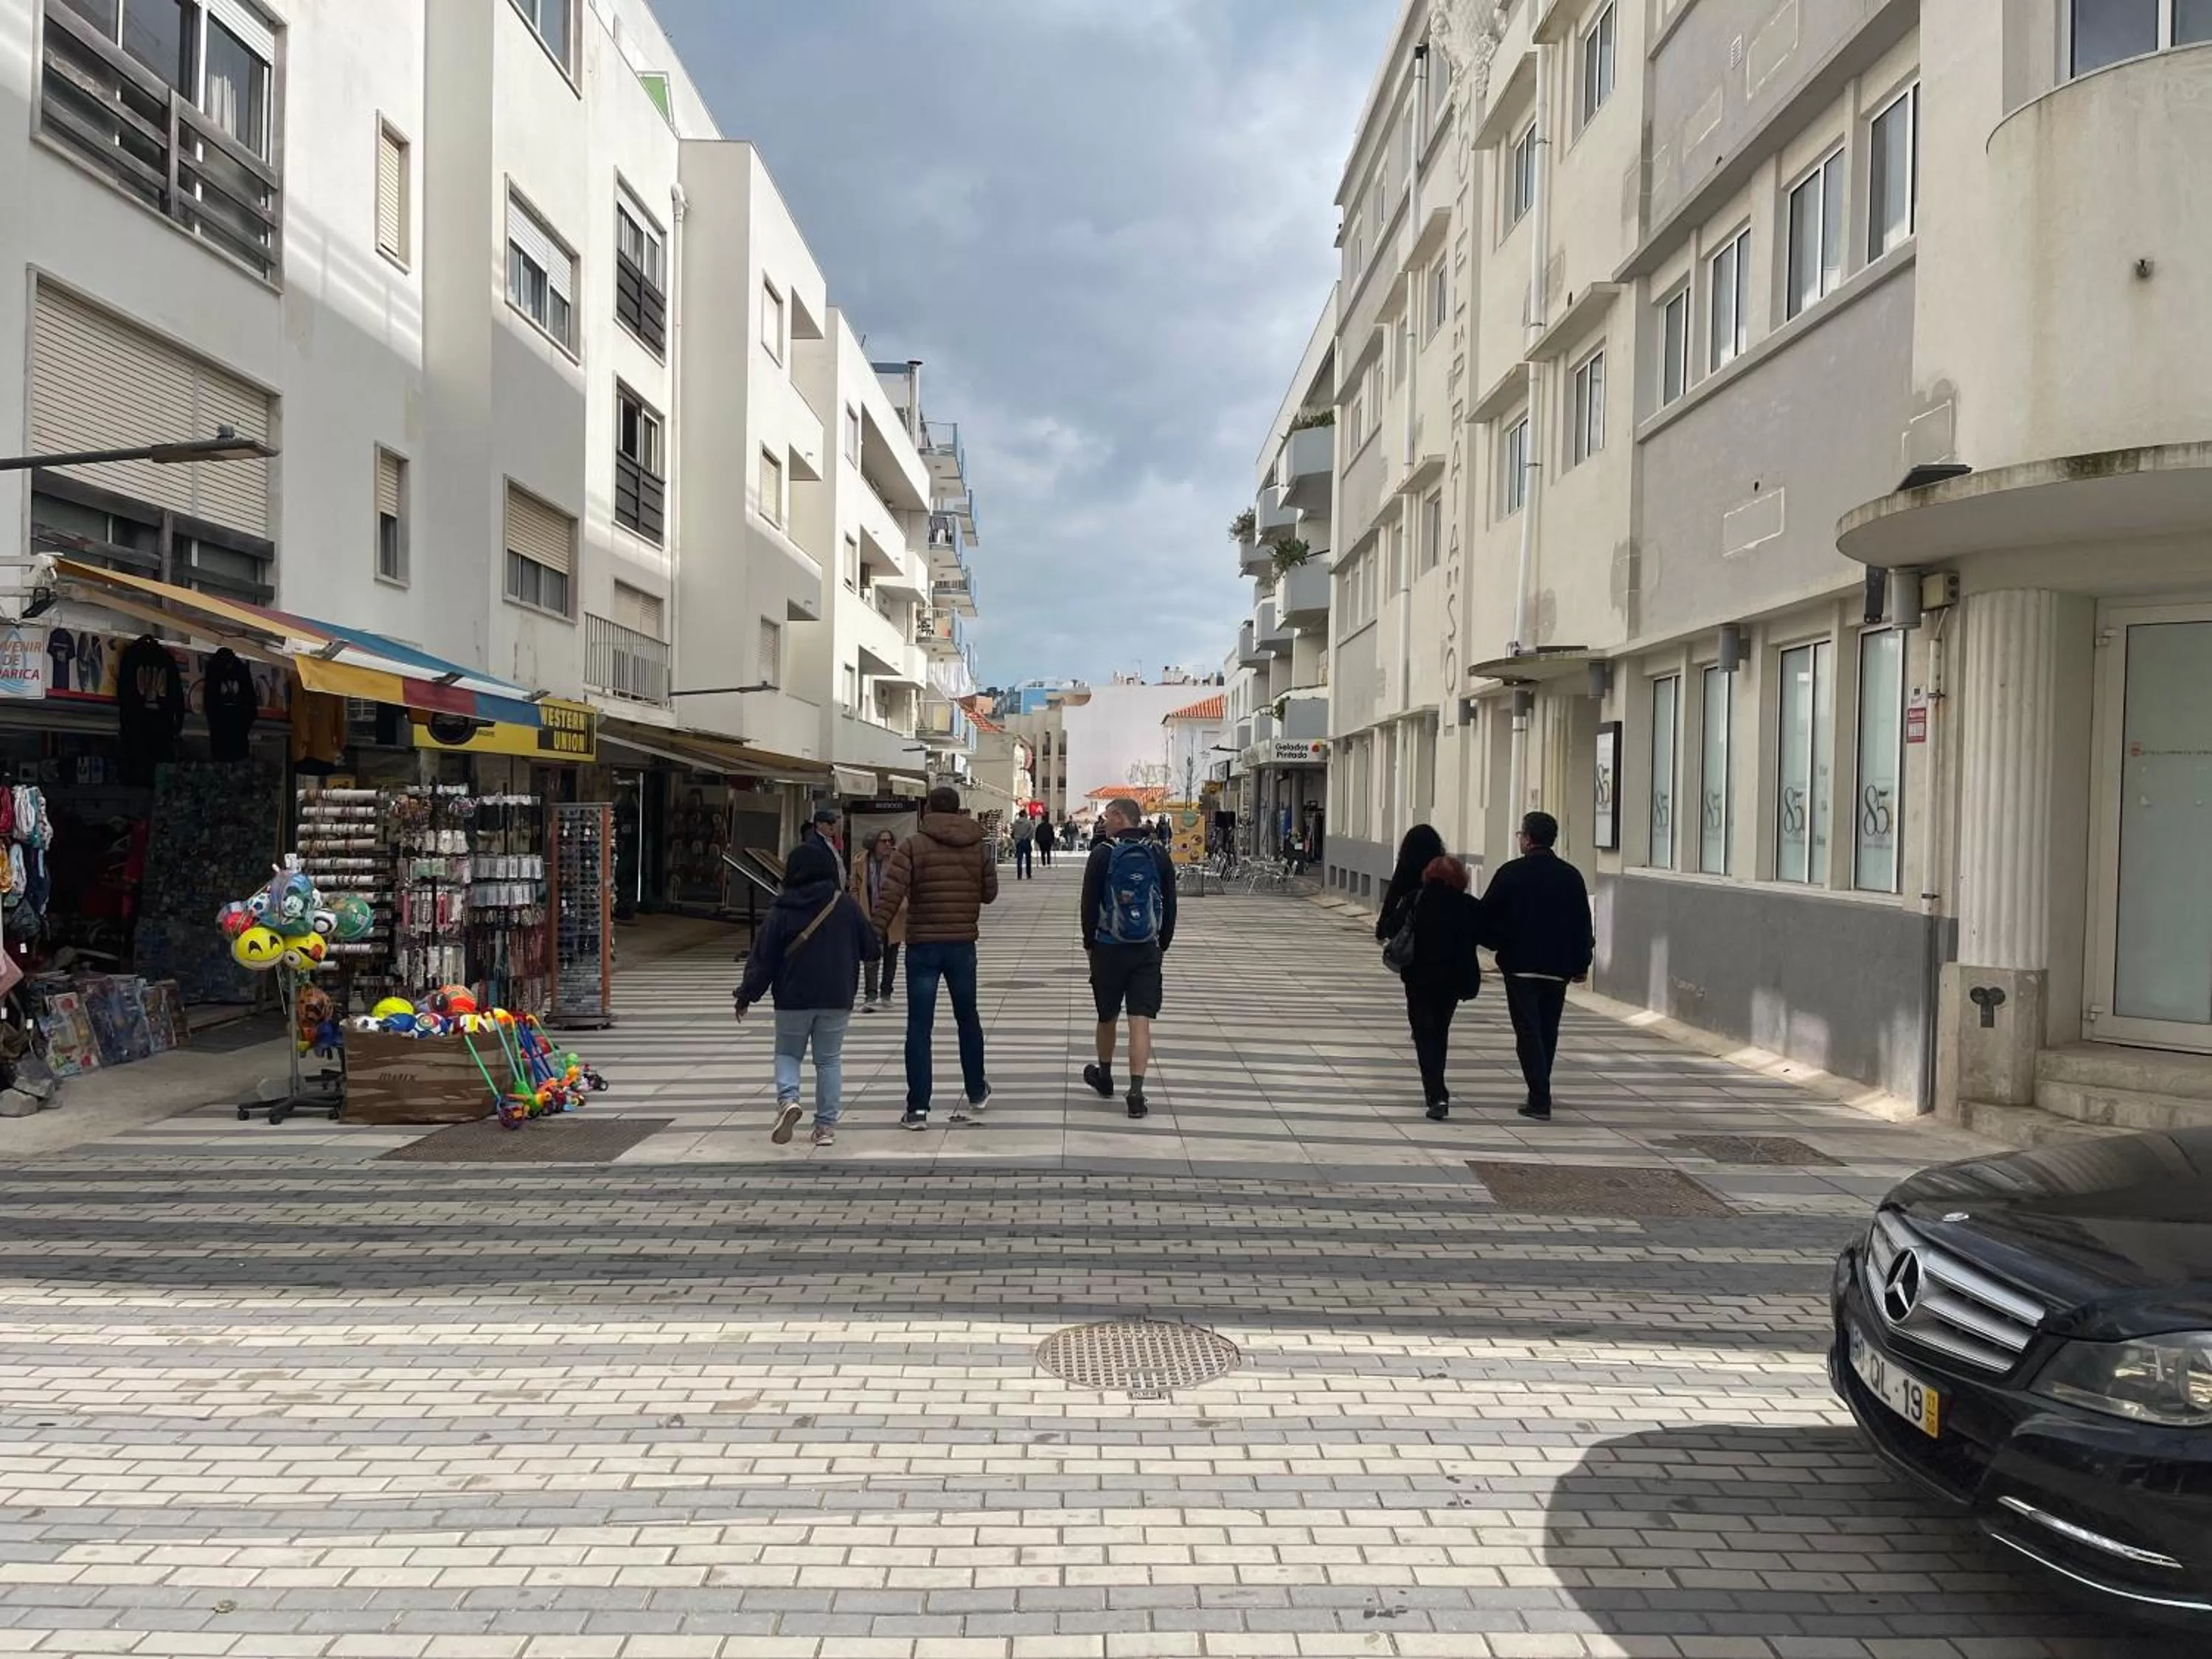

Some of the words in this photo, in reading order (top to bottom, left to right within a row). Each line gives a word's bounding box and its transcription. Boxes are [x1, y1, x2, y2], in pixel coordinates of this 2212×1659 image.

[1454, 82, 1472, 323] HOTEL
[1448, 352, 1464, 563] PRAIA
[0, 669, 39, 681] ARICA
[3, 654, 21, 666] DE
[1444, 593, 1456, 730] SOL
[554, 731, 585, 752] UNION
[1275, 742, 1309, 751] Gelados
[1784, 786, 1804, 834] 85
[1864, 785, 1890, 836] 85
